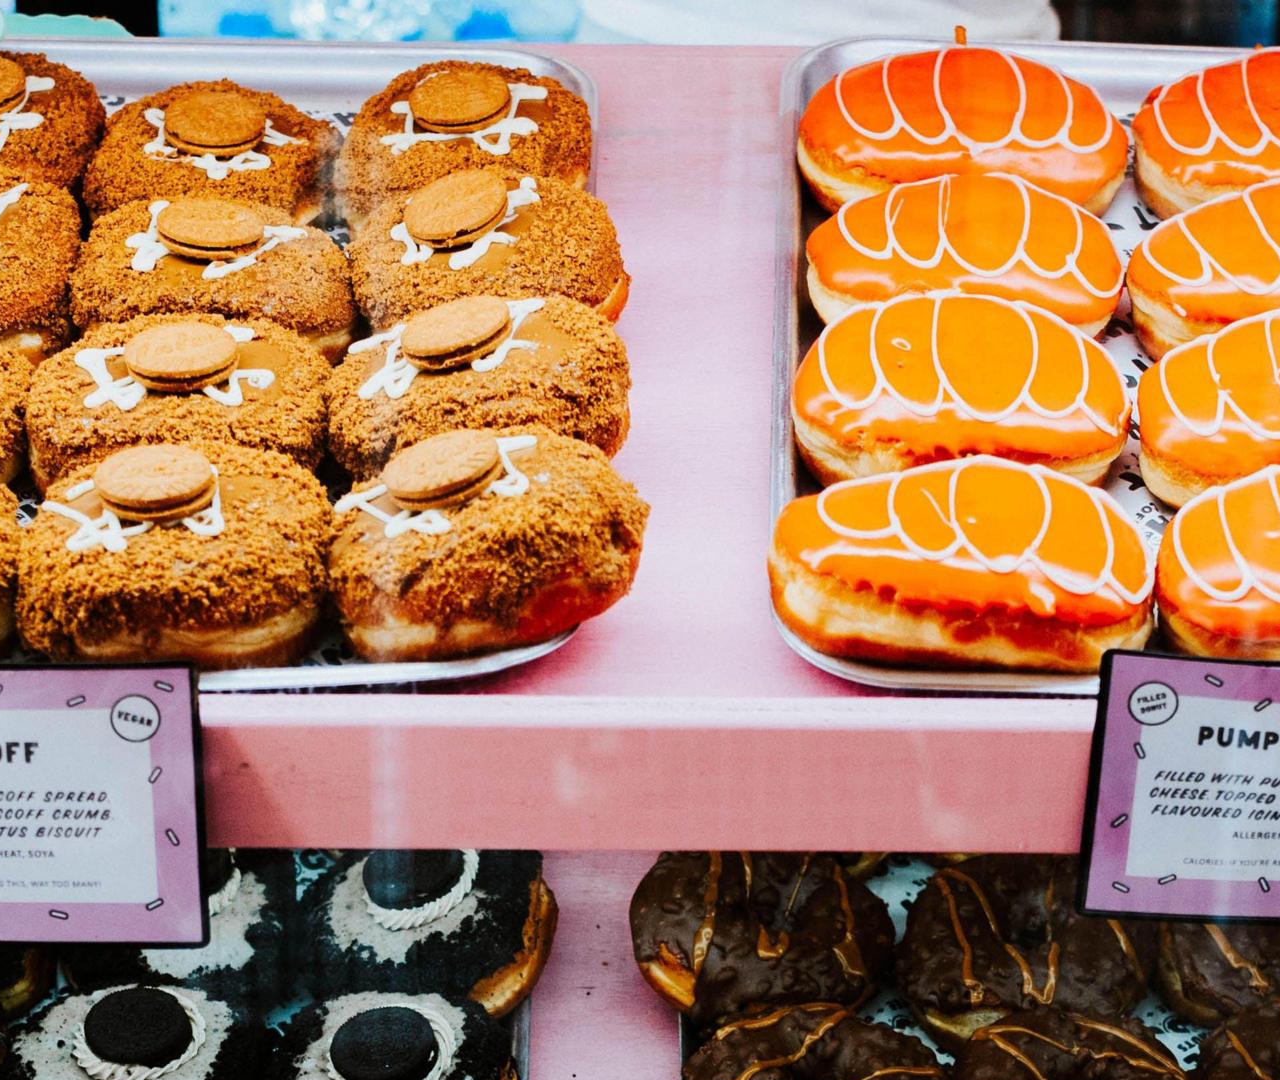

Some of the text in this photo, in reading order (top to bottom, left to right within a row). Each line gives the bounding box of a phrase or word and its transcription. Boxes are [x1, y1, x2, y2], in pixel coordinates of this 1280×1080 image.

[1154, 770, 1206, 783] FILLED
[1210, 773, 1255, 785] WITH
[1215, 790, 1277, 805] TOPPED
[1151, 804, 1242, 819] FLAVOURED
[35, 826, 102, 838] BISCUIT
